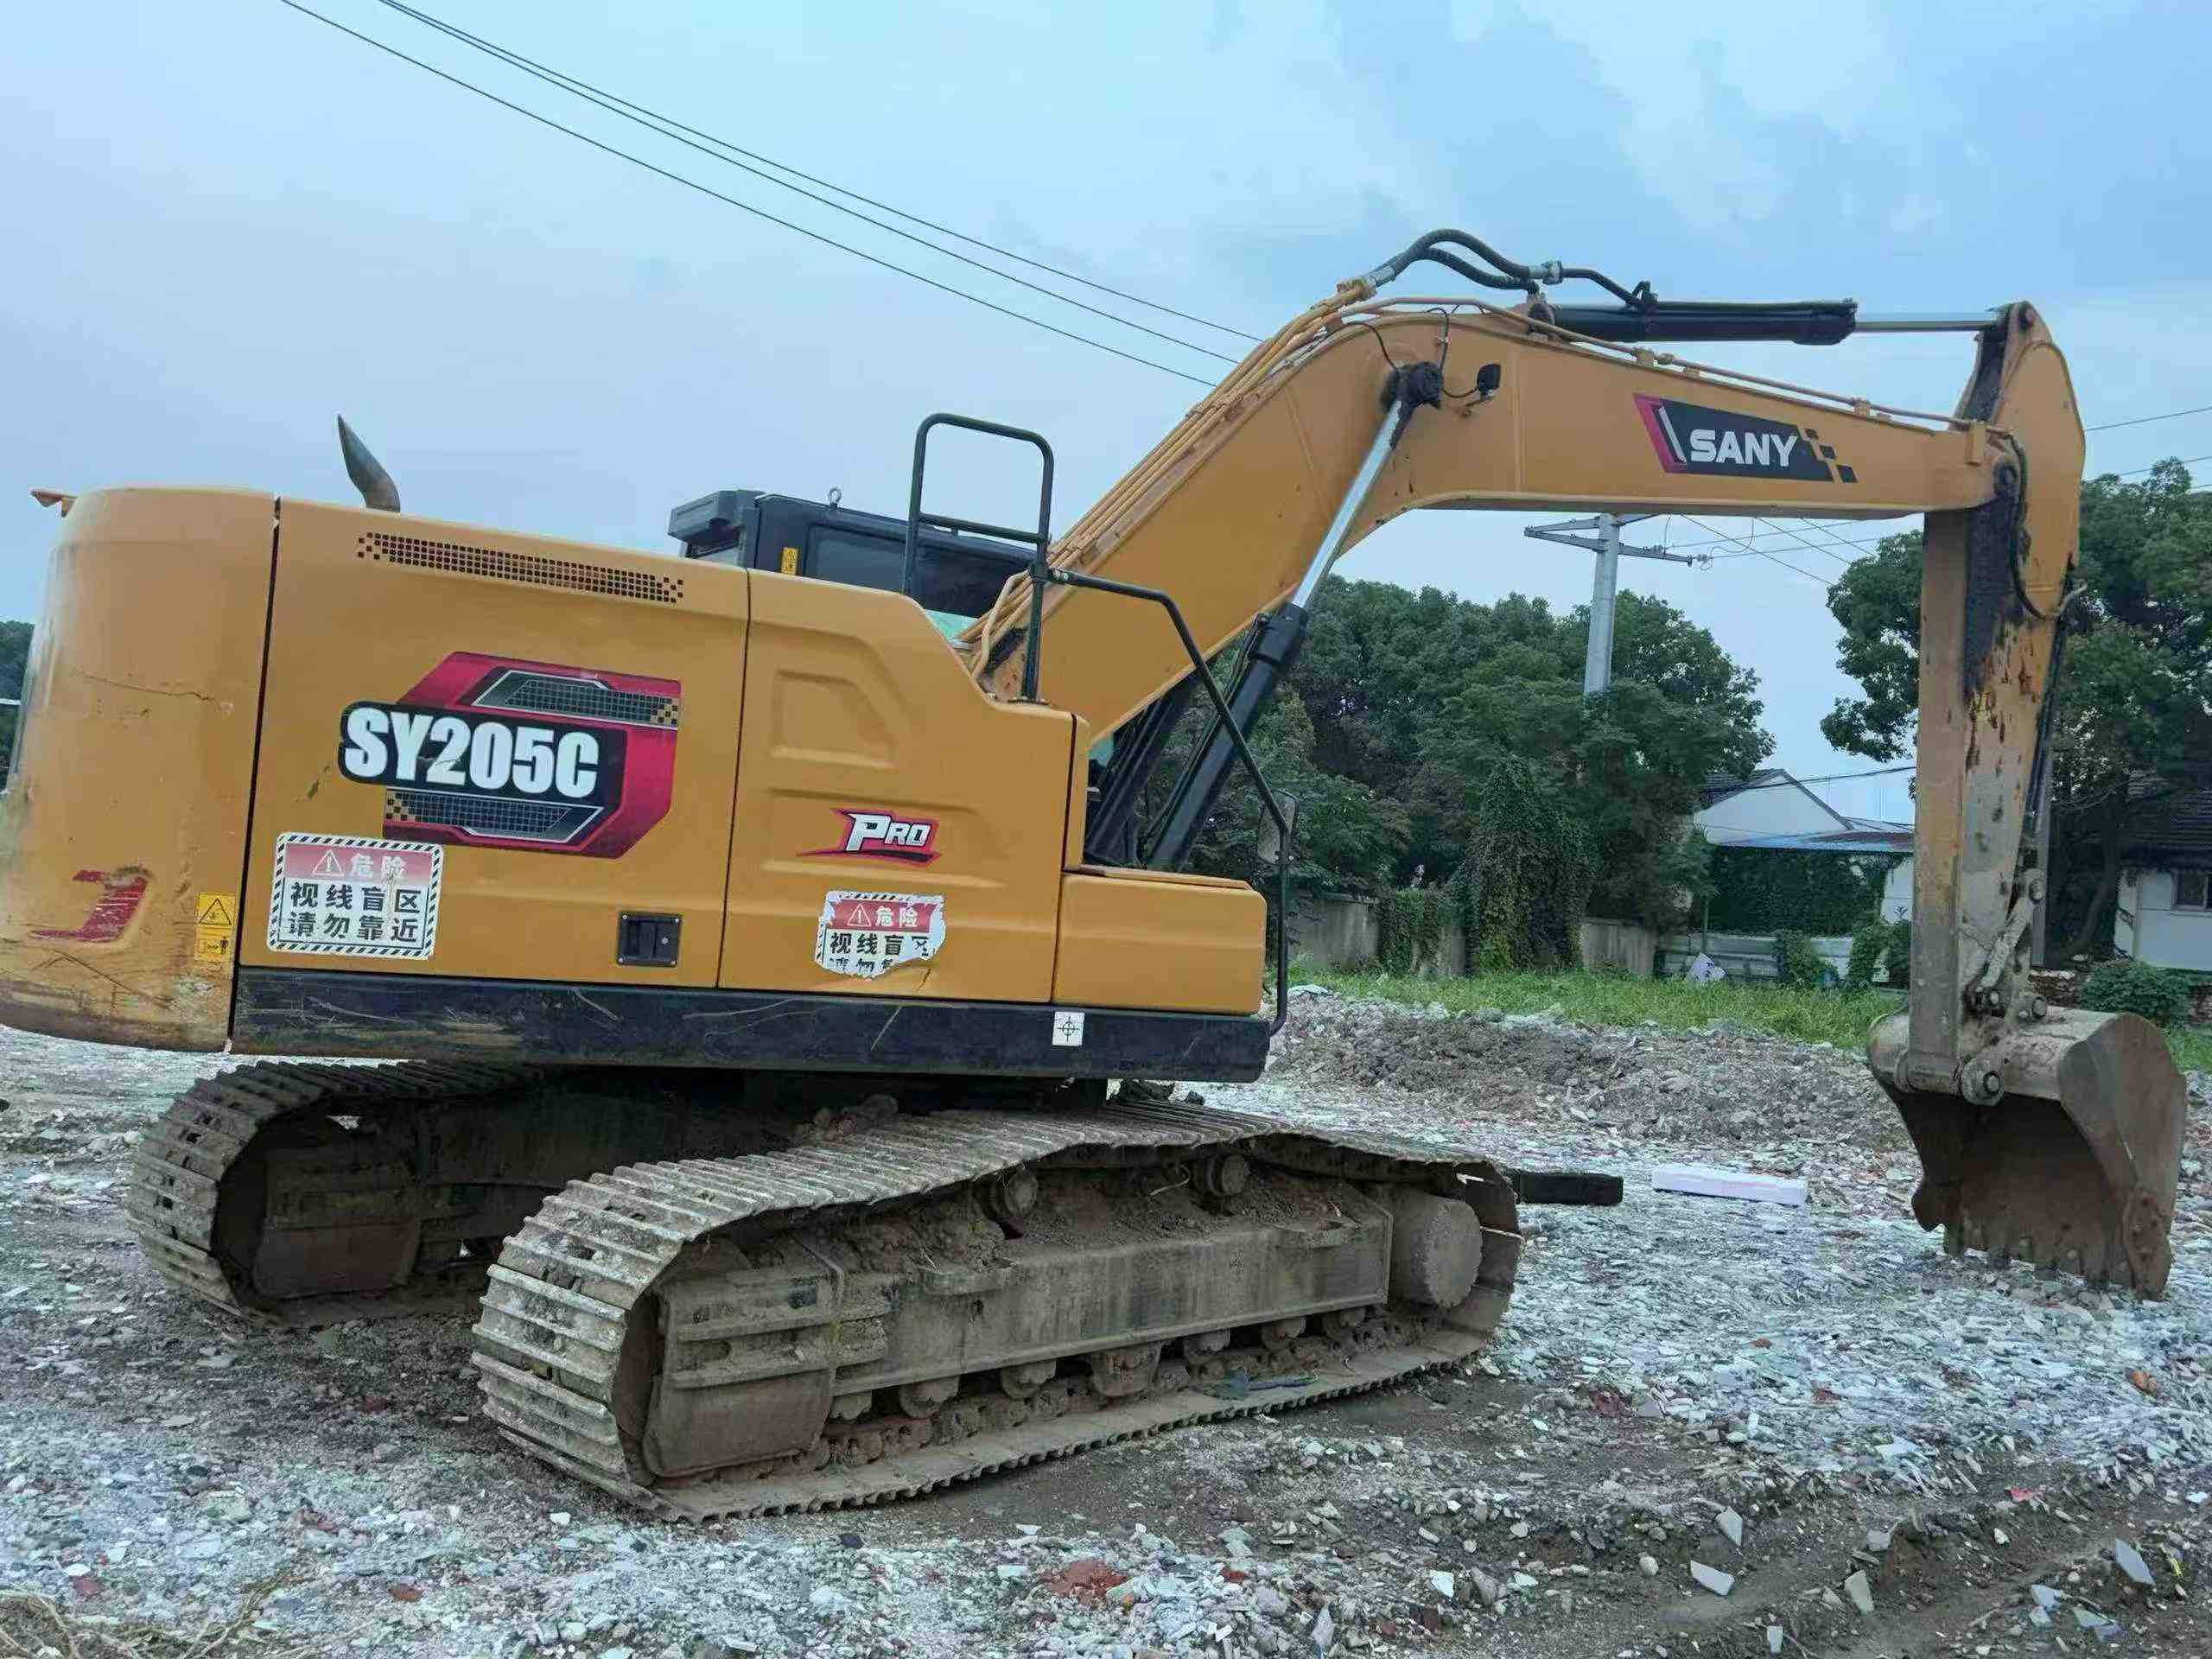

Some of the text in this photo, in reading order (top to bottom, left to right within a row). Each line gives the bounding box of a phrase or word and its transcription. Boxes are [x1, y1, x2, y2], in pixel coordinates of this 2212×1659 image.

[1689, 429, 1798, 467] SANY
[345, 707, 600, 798] SY205C
[350, 853, 406, 879] 危险
[290, 882, 422, 913] 视线盲区
[288, 912, 418, 942] 请勿靠近
[875, 906, 918, 928] 危险
